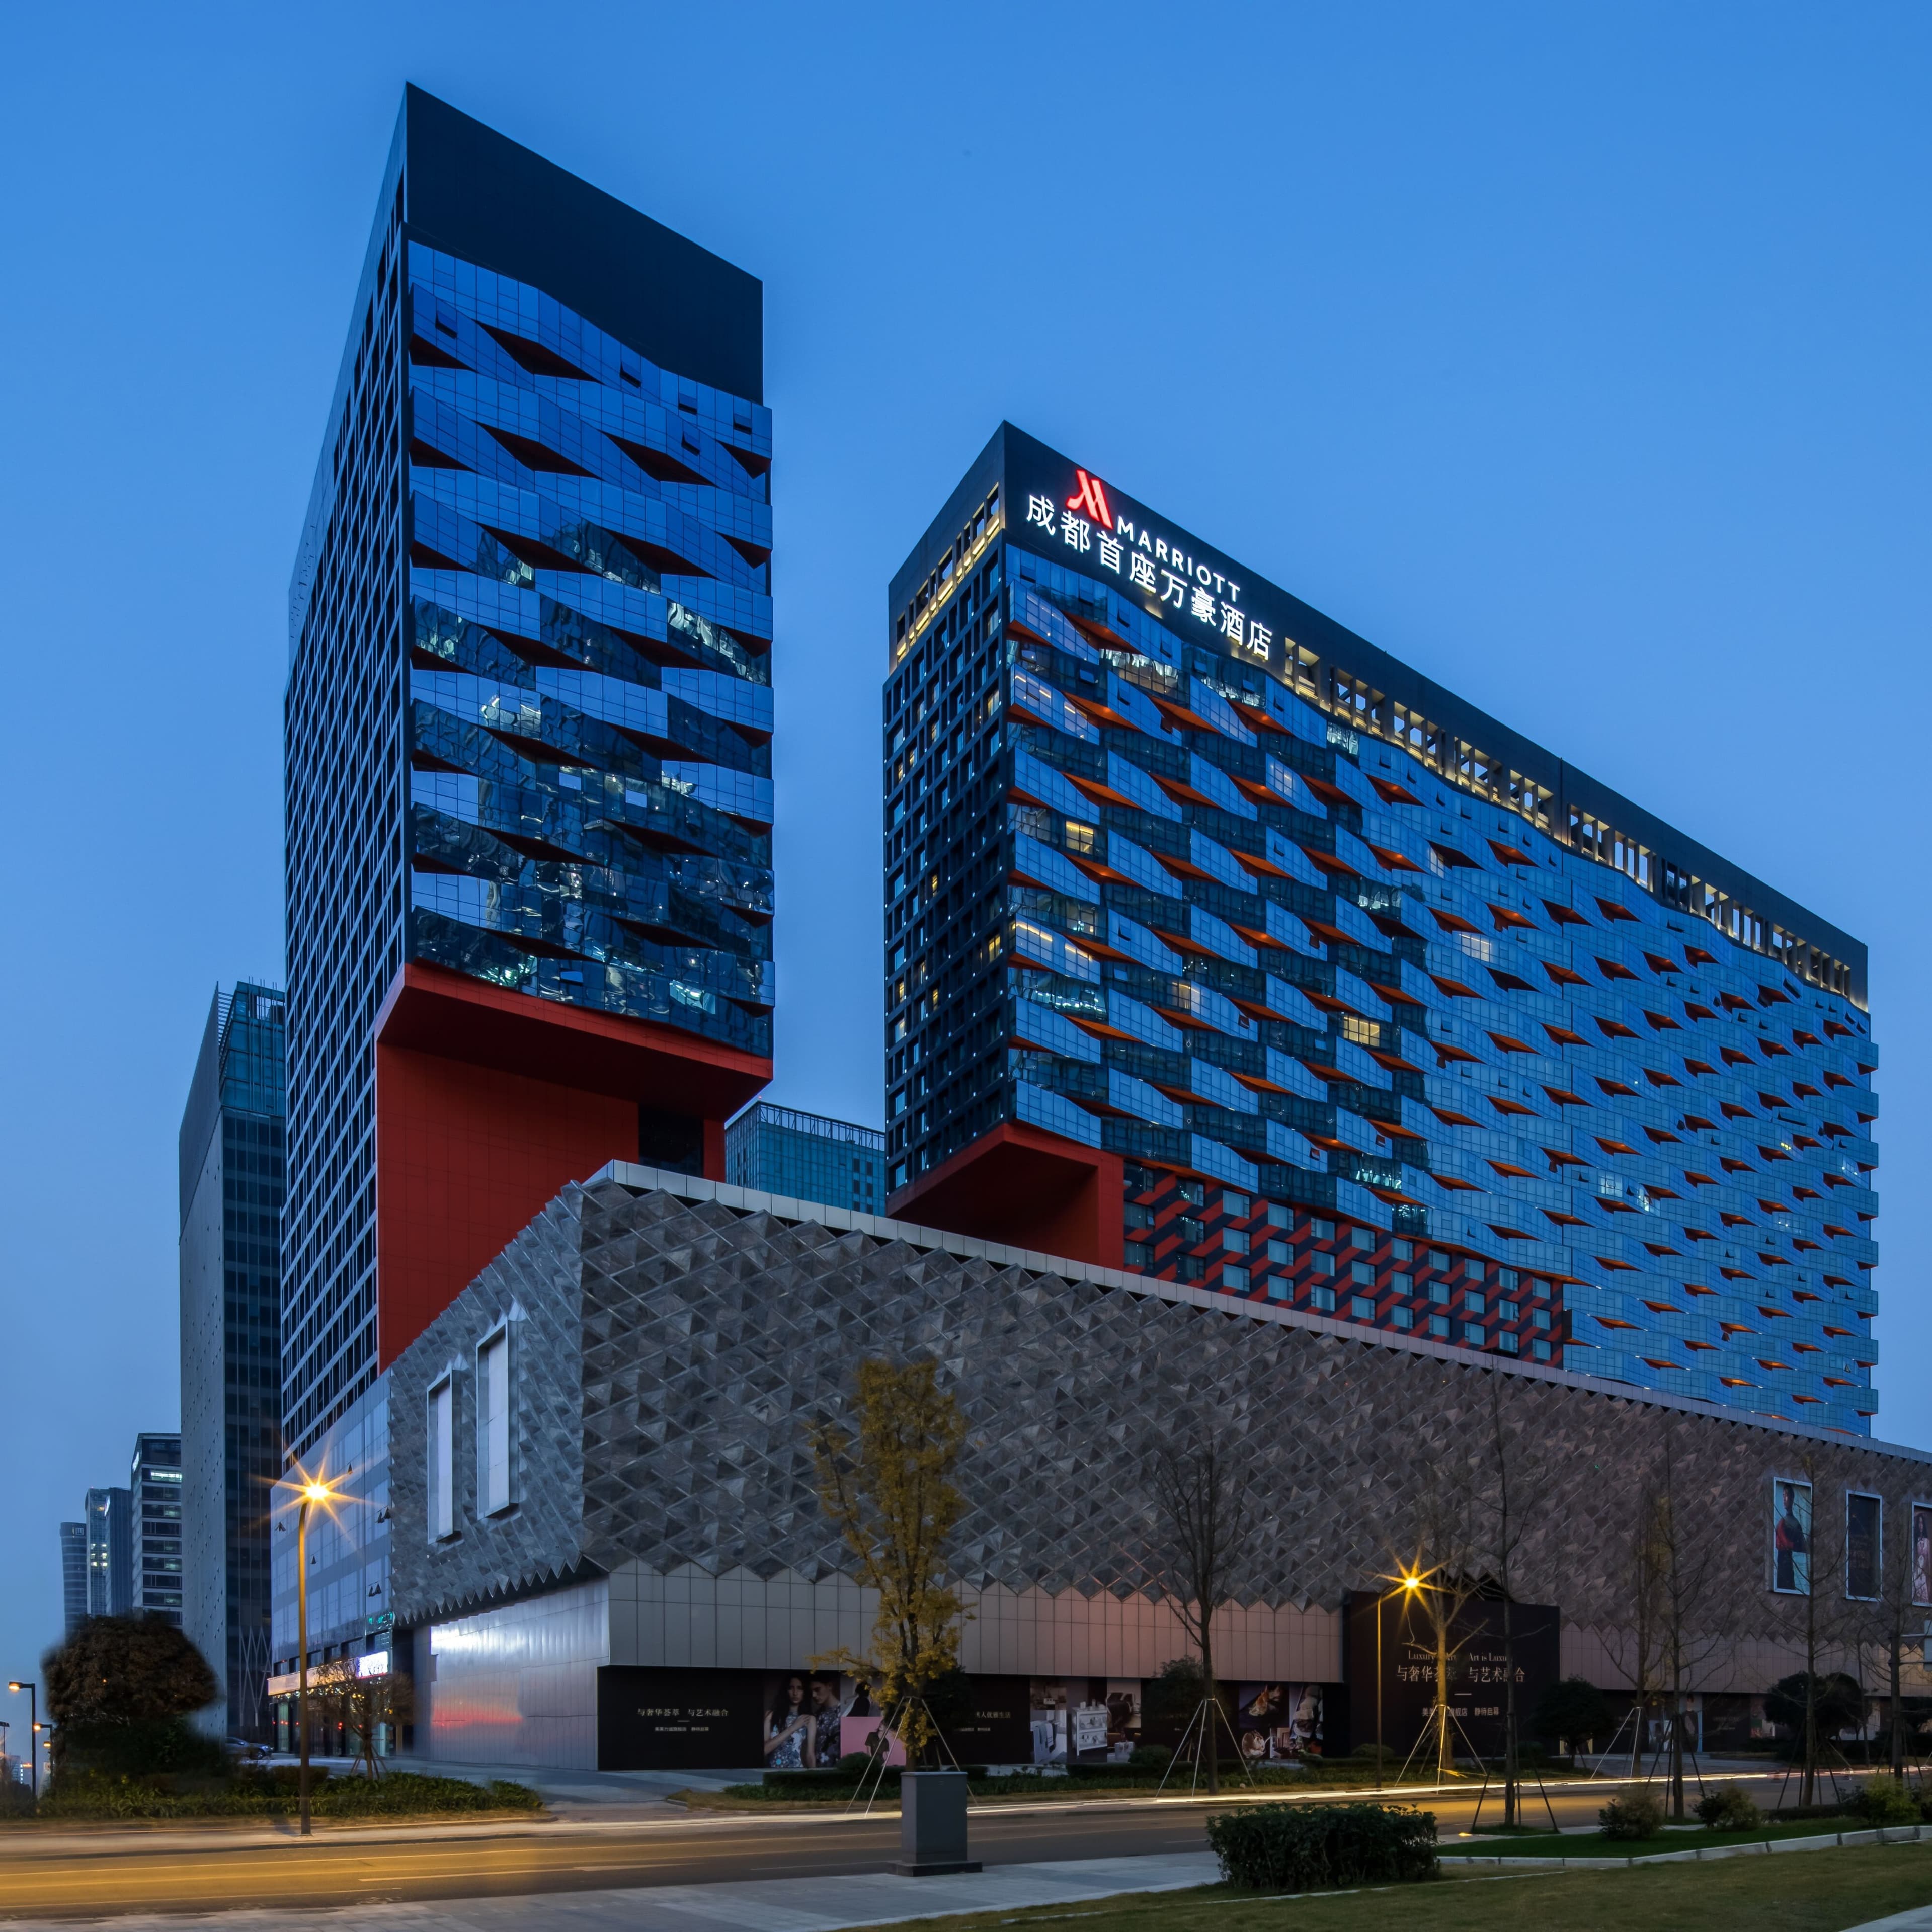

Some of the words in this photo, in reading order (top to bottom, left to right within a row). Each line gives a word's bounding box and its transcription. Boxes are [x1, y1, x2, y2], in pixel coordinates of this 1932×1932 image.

[1026, 495, 1272, 661] 成都首座万豪酒店
[1117, 515, 1240, 602] MARRIOTT
[1469, 1652, 1479, 1661] Art
